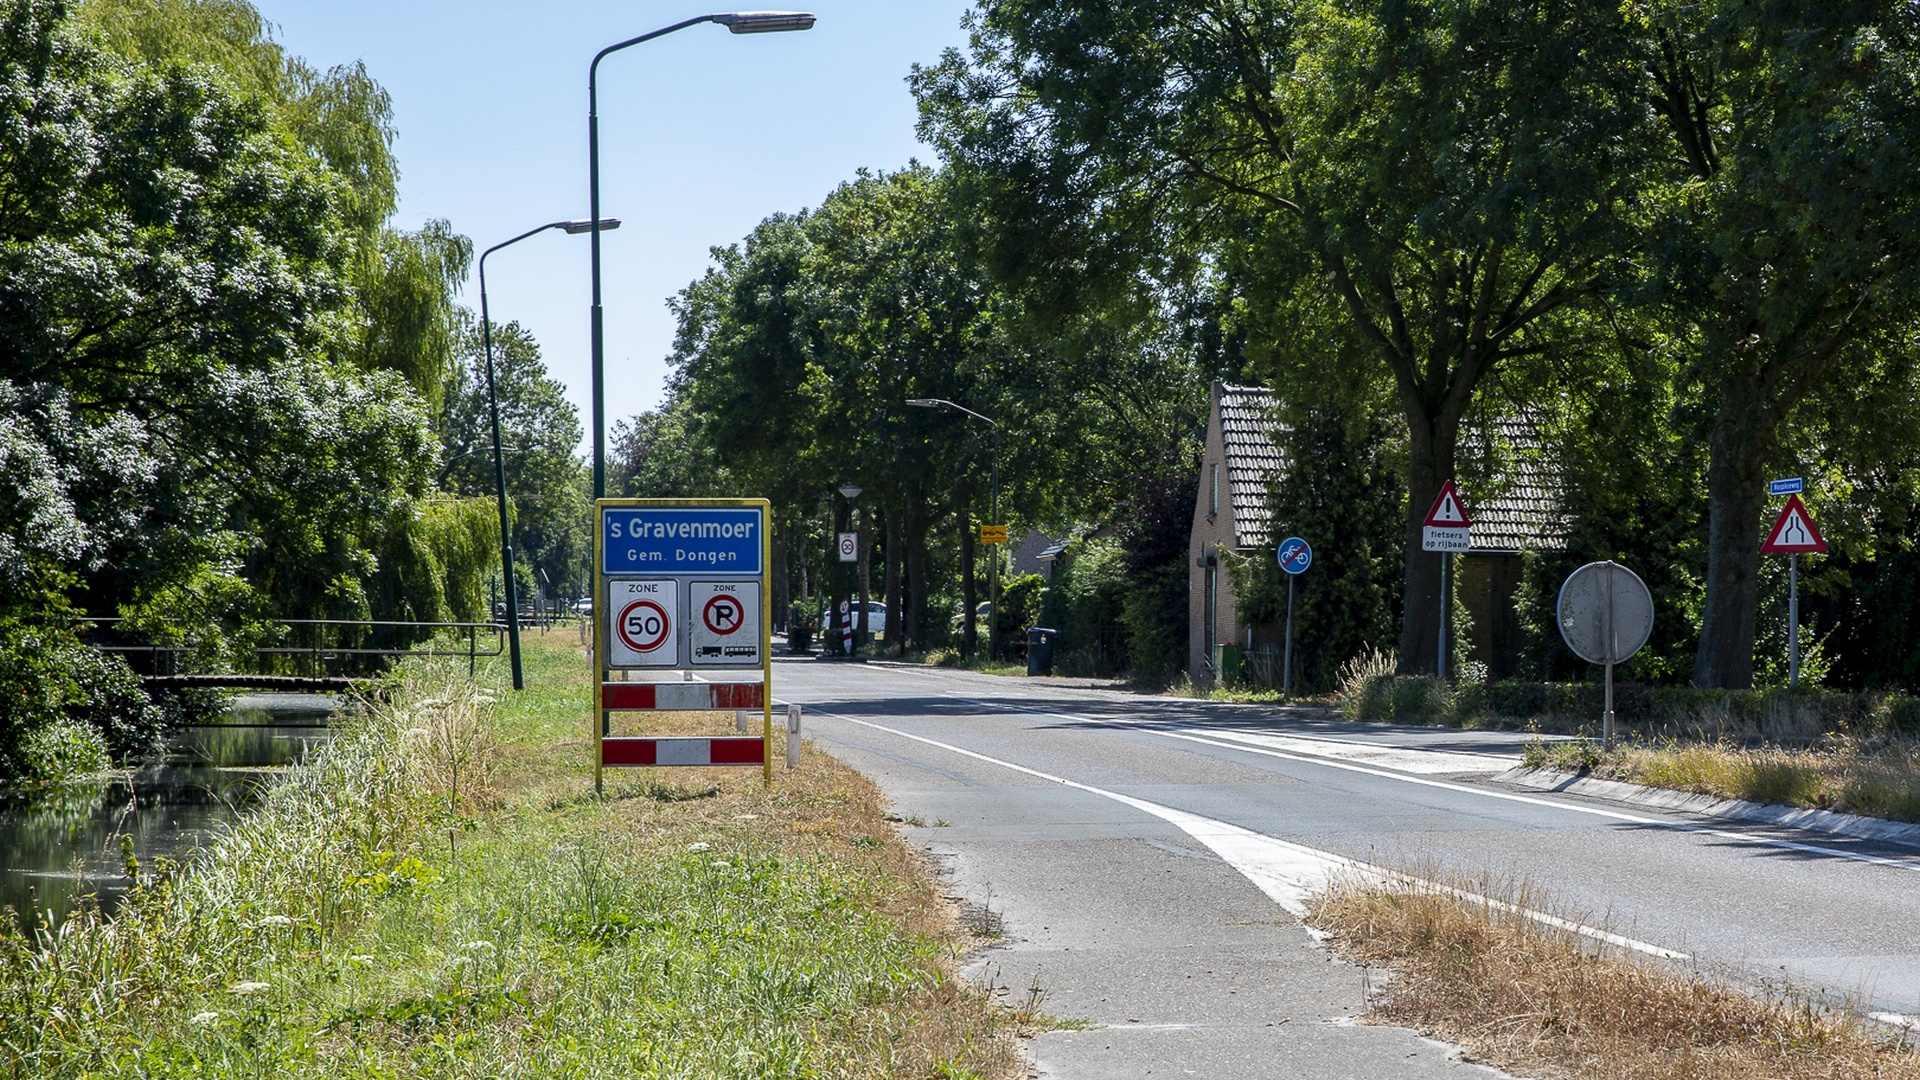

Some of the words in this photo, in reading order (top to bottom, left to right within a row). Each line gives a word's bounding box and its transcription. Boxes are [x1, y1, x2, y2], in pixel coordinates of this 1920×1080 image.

[607, 517, 622, 538] 's
[629, 518, 754, 539] Gravenmoer
[1431, 531, 1463, 539] fietsers
[1438, 540, 1468, 549] rijbaan
[627, 549, 667, 561] Gem.
[676, 549, 737, 564] Dongen
[628, 584, 659, 593] ZONE
[713, 584, 737, 592] ZONE
[716, 605, 734, 627] P
[628, 616, 661, 636] 50
